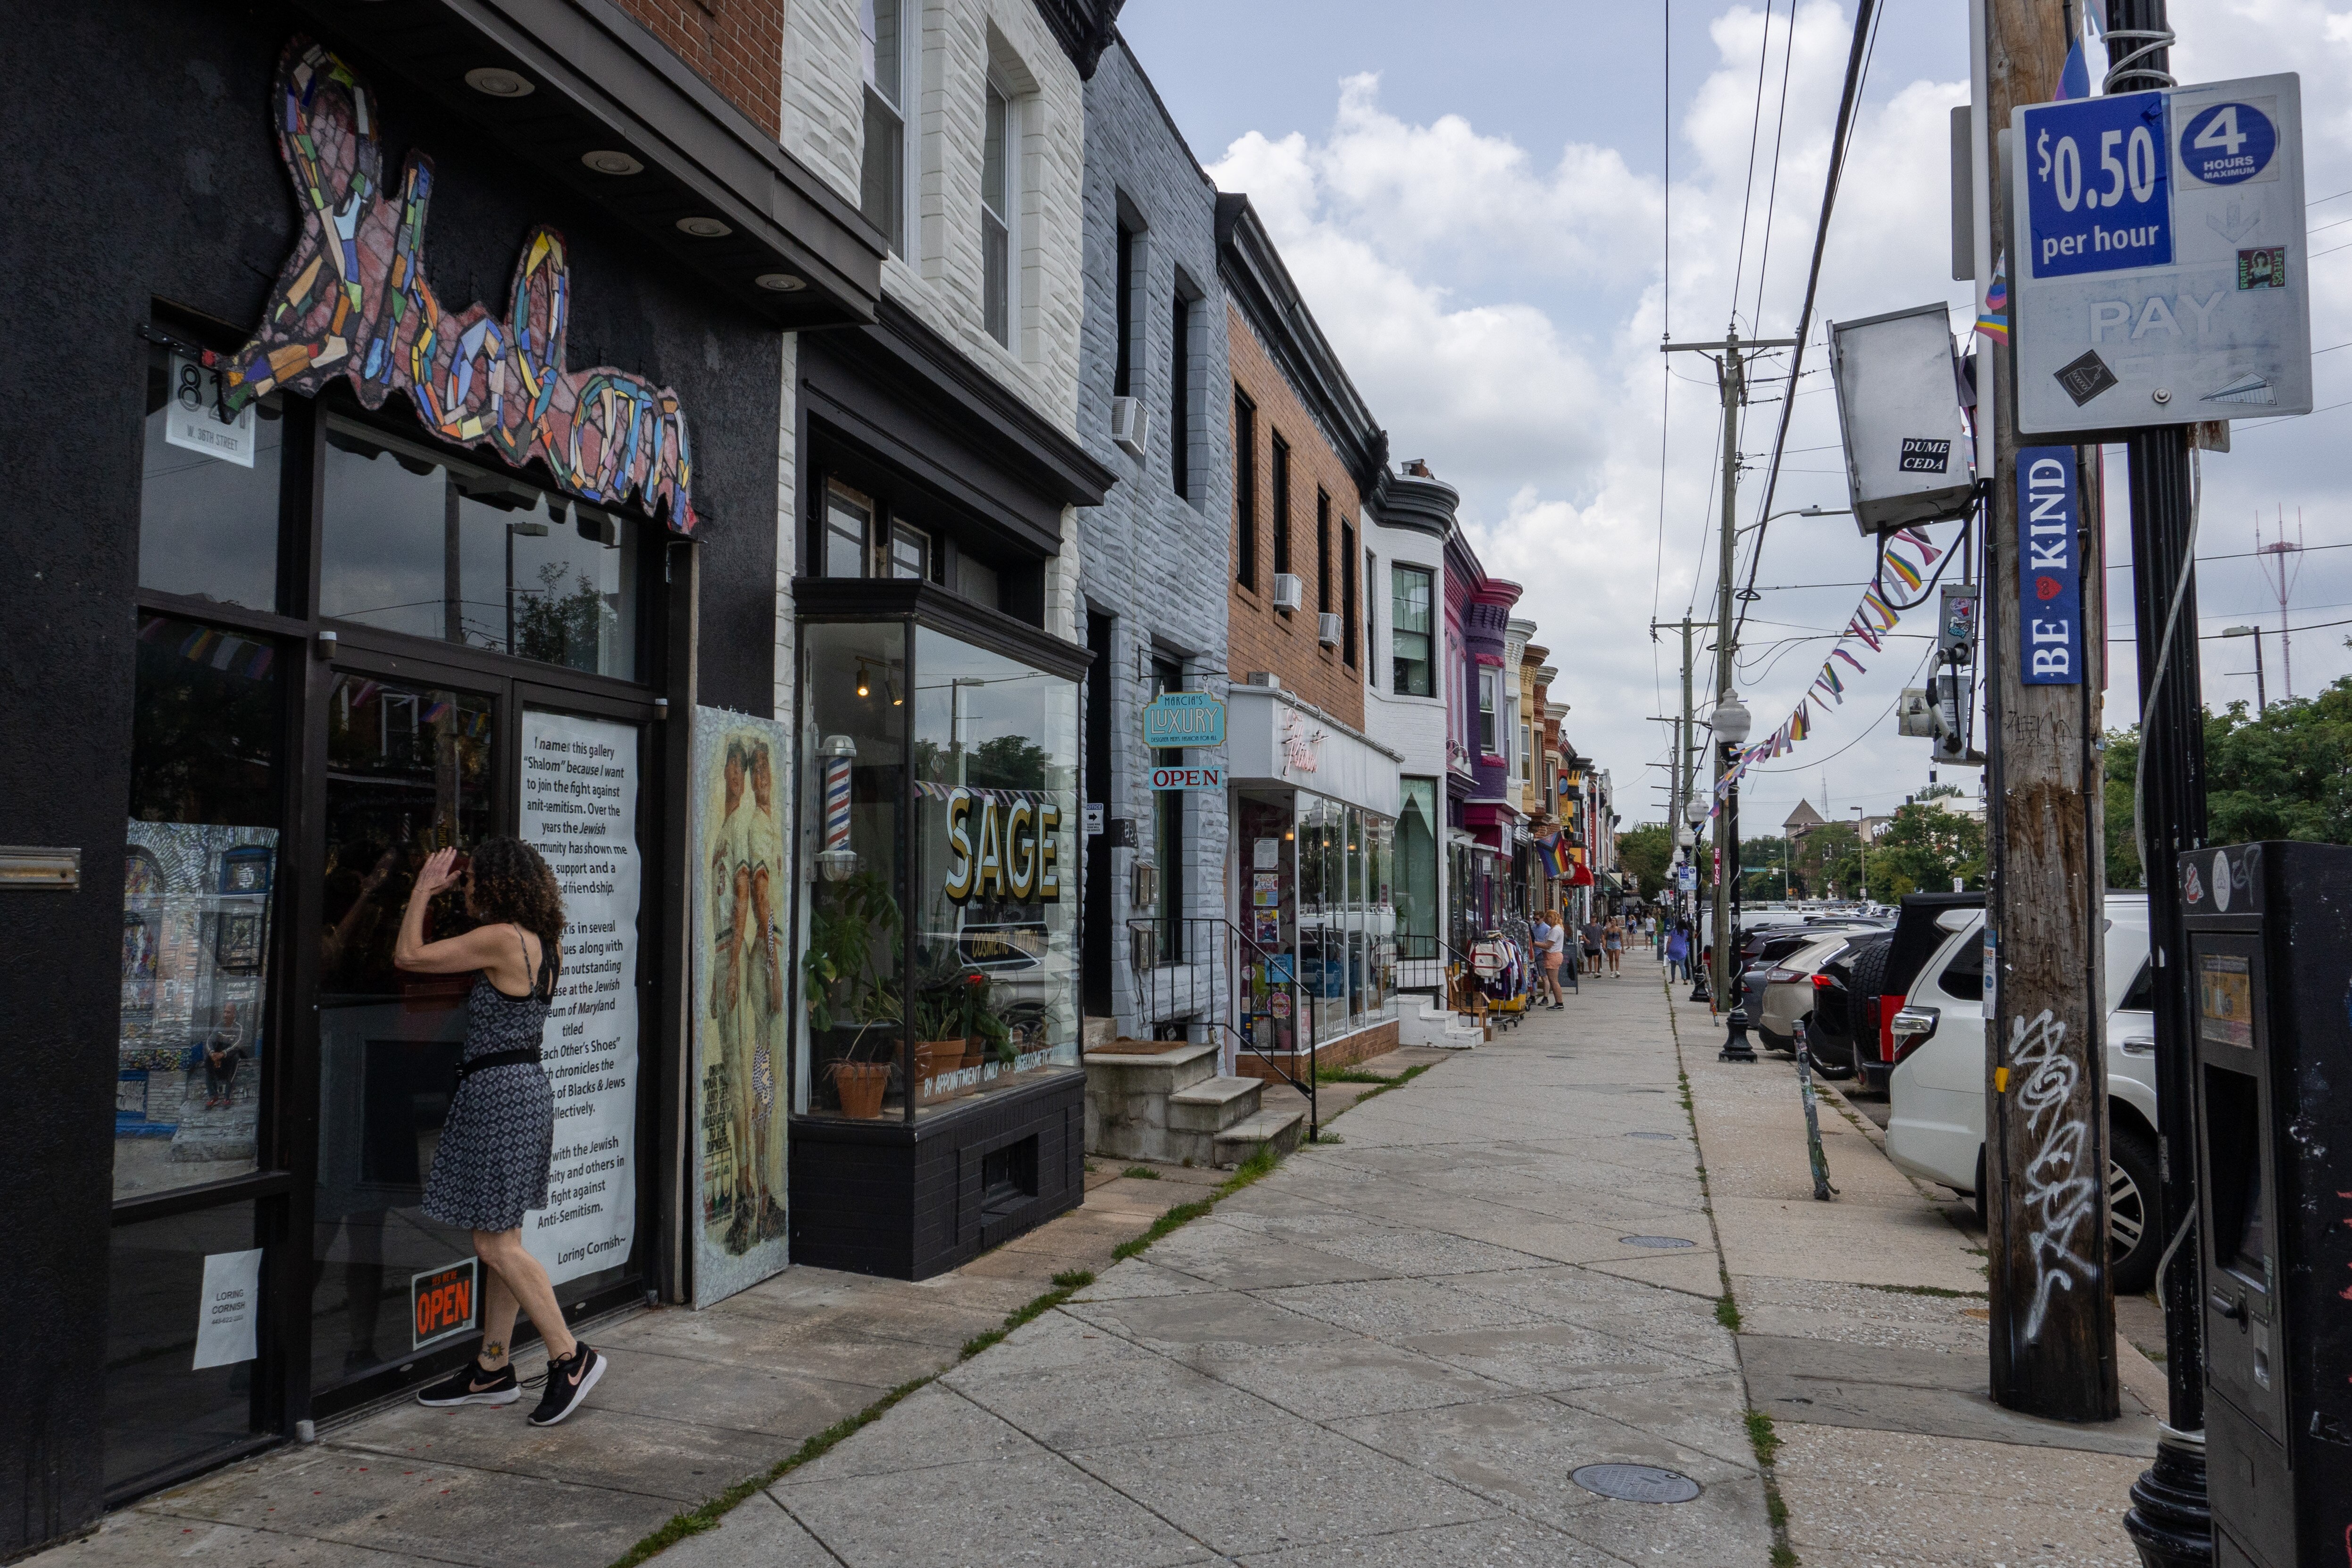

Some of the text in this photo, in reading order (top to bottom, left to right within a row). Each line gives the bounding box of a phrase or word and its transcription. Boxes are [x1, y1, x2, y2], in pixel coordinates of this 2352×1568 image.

[2194, 106, 2247, 155] 4
[2037, 126, 2155, 212] $0.50
[2204, 156, 2253, 171] HOURS
[2204, 166, 2255, 179] MAXIMUM
[2043, 225, 2159, 264] per hour
[2090, 291, 2227, 343] PAY
[217, 434, 238, 450] STREET
[1902, 440, 1949, 456] DUME
[1902, 457, 1944, 470] CEDA
[2030, 459, 2067, 570] KIND
[2033, 619, 2068, 676] BE
[1165, 696, 1202, 706] MARCIA'S
[1151, 708, 1218, 734] LUXURY
[572, 741, 587, 754] this
[589, 744, 614, 760] gallery
[567, 760, 599, 776] because
[605, 767, 624, 778] want
[1153, 770, 1219, 787] OPEN
[527, 777, 620, 799] to join the fight against
[527, 799, 620, 817] anit-semitism. Over the
[542, 821, 606, 835] years the Jewish
[569, 841, 583, 854] has
[584, 842, 613, 854] shown
[614, 846, 627, 854] me
[945, 786, 1061, 903] SAGE
[1715, 848, 1719, 859] BE
[556, 861, 587, 877] support
[590, 861, 608, 873] and
[611, 864, 616, 873] a
[568, 881, 614, 896] friendship.
[569, 922, 575, 934] is
[578, 922, 587, 934] in
[589, 920, 616, 933] several
[579, 941, 604, 956] along
[605, 939, 623, 952] with
[973, 931, 1009, 957] COSMETIC
[571, 959, 621, 974] outstanding
[569, 984, 577, 995] at
[579, 981, 592, 994] the
[594, 978, 620, 993] Jewish
[568, 1002, 577, 1015] of
[578, 998, 615, 1016] Maryland
[562, 1022, 584, 1037] titled
[555, 1061, 599, 1079] chronicles
[601, 1058, 614, 1071] the
[557, 1085, 566, 1099] of
[568, 1080, 595, 1097] Blacks
[597, 1079, 603, 1091] &
[604, 1077, 626, 1091] Jews
[924, 1077, 933, 1098] BY
[935, 1064, 981, 1094] APPOINTMENT
[984, 1060, 1000, 1082] ONLY
[552, 1135, 619, 1162] with the Jewish
[567, 1163, 584, 1179] and
[586, 1159, 615, 1174] others
[617, 1155, 625, 1168] in
[551, 1180, 606, 1206] fight against
[538, 1203, 603, 1229] Anti-Semitism.
[558, 1247, 584, 1265] Loring
[216, 1289, 244, 1301] LORING
[212, 1301, 245, 1314] CORNISH
[417, 1280, 469, 1335] OPEN
